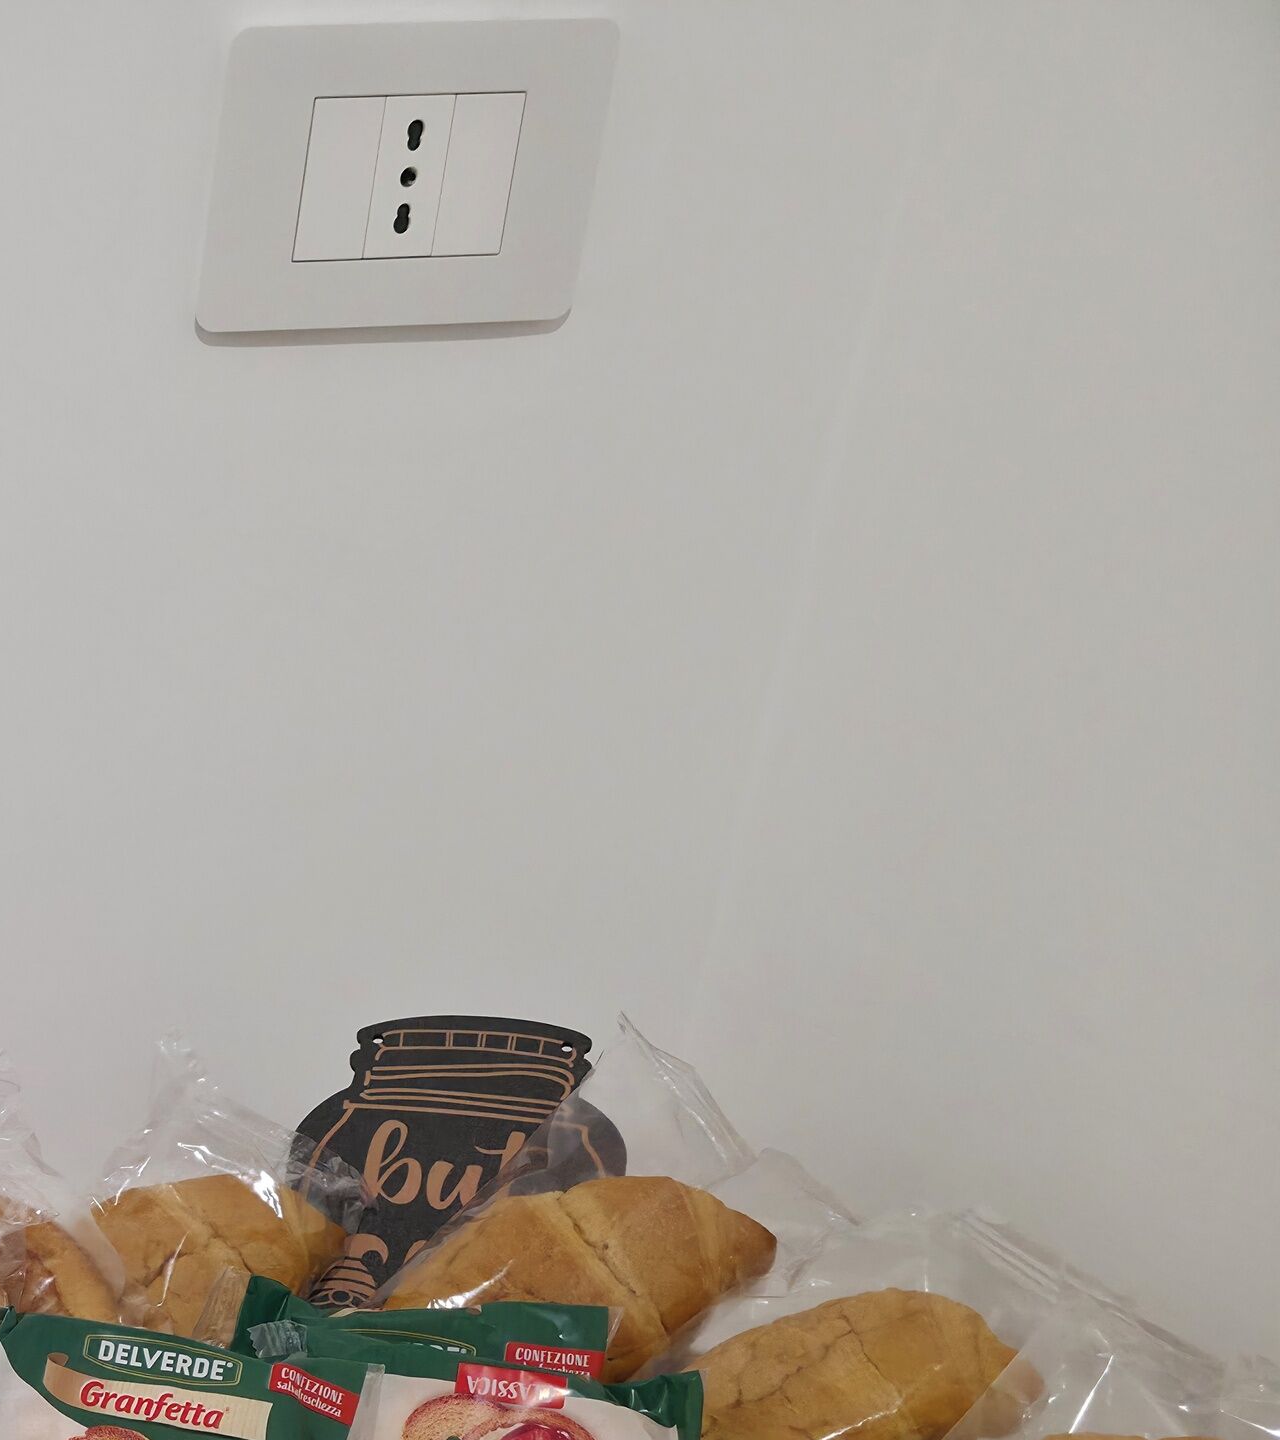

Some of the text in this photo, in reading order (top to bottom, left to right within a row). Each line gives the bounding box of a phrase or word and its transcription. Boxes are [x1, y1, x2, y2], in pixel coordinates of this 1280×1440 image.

[98, 1340, 224, 1381] DELVERDE
[515, 1347, 590, 1368] CONFEZIONE
[281, 1367, 344, 1405] CONFEZIONE
[466, 1374, 558, 1400] ASSICA
[80, 1381, 224, 1430] Granfetta
